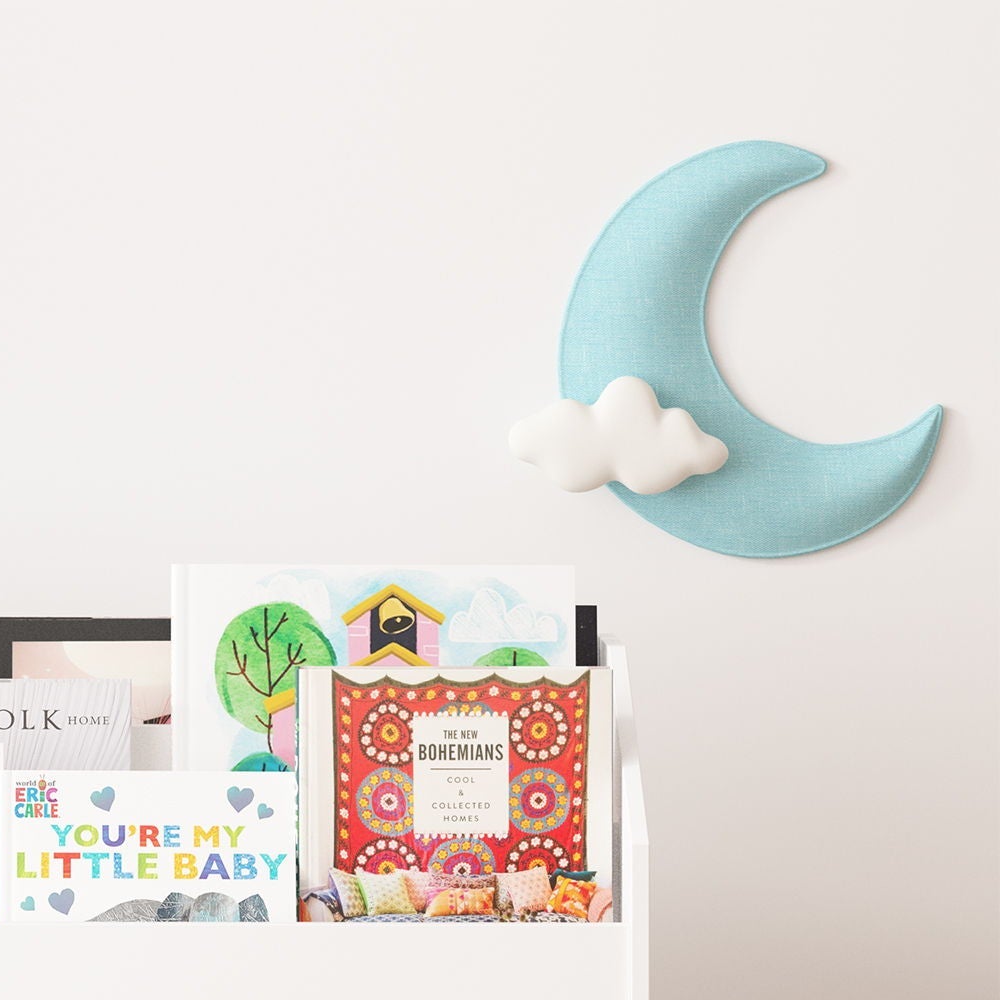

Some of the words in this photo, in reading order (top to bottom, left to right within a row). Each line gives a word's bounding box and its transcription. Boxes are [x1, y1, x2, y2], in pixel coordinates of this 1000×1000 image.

[67, 715, 111, 726] HOME
[443, 729, 458, 740] THE
[460, 729, 479, 740] NEW
[418, 743, 504, 761] BOHEMIANS
[15, 779, 37, 787] world
[47, 779, 56, 787] of
[446, 776, 476, 784] COOL
[15, 787, 58, 803] ERIC
[458, 789, 464, 797] &
[14, 802, 59, 819] CARLE
[431, 801, 491, 810] COLLECTED
[443, 814, 480, 823] HOMES
[50, 823, 181, 848] YOU'RE
[193, 824, 246, 848] MY
[16, 851, 159, 880] LITTLE
[173, 852, 288, 880] BABY
